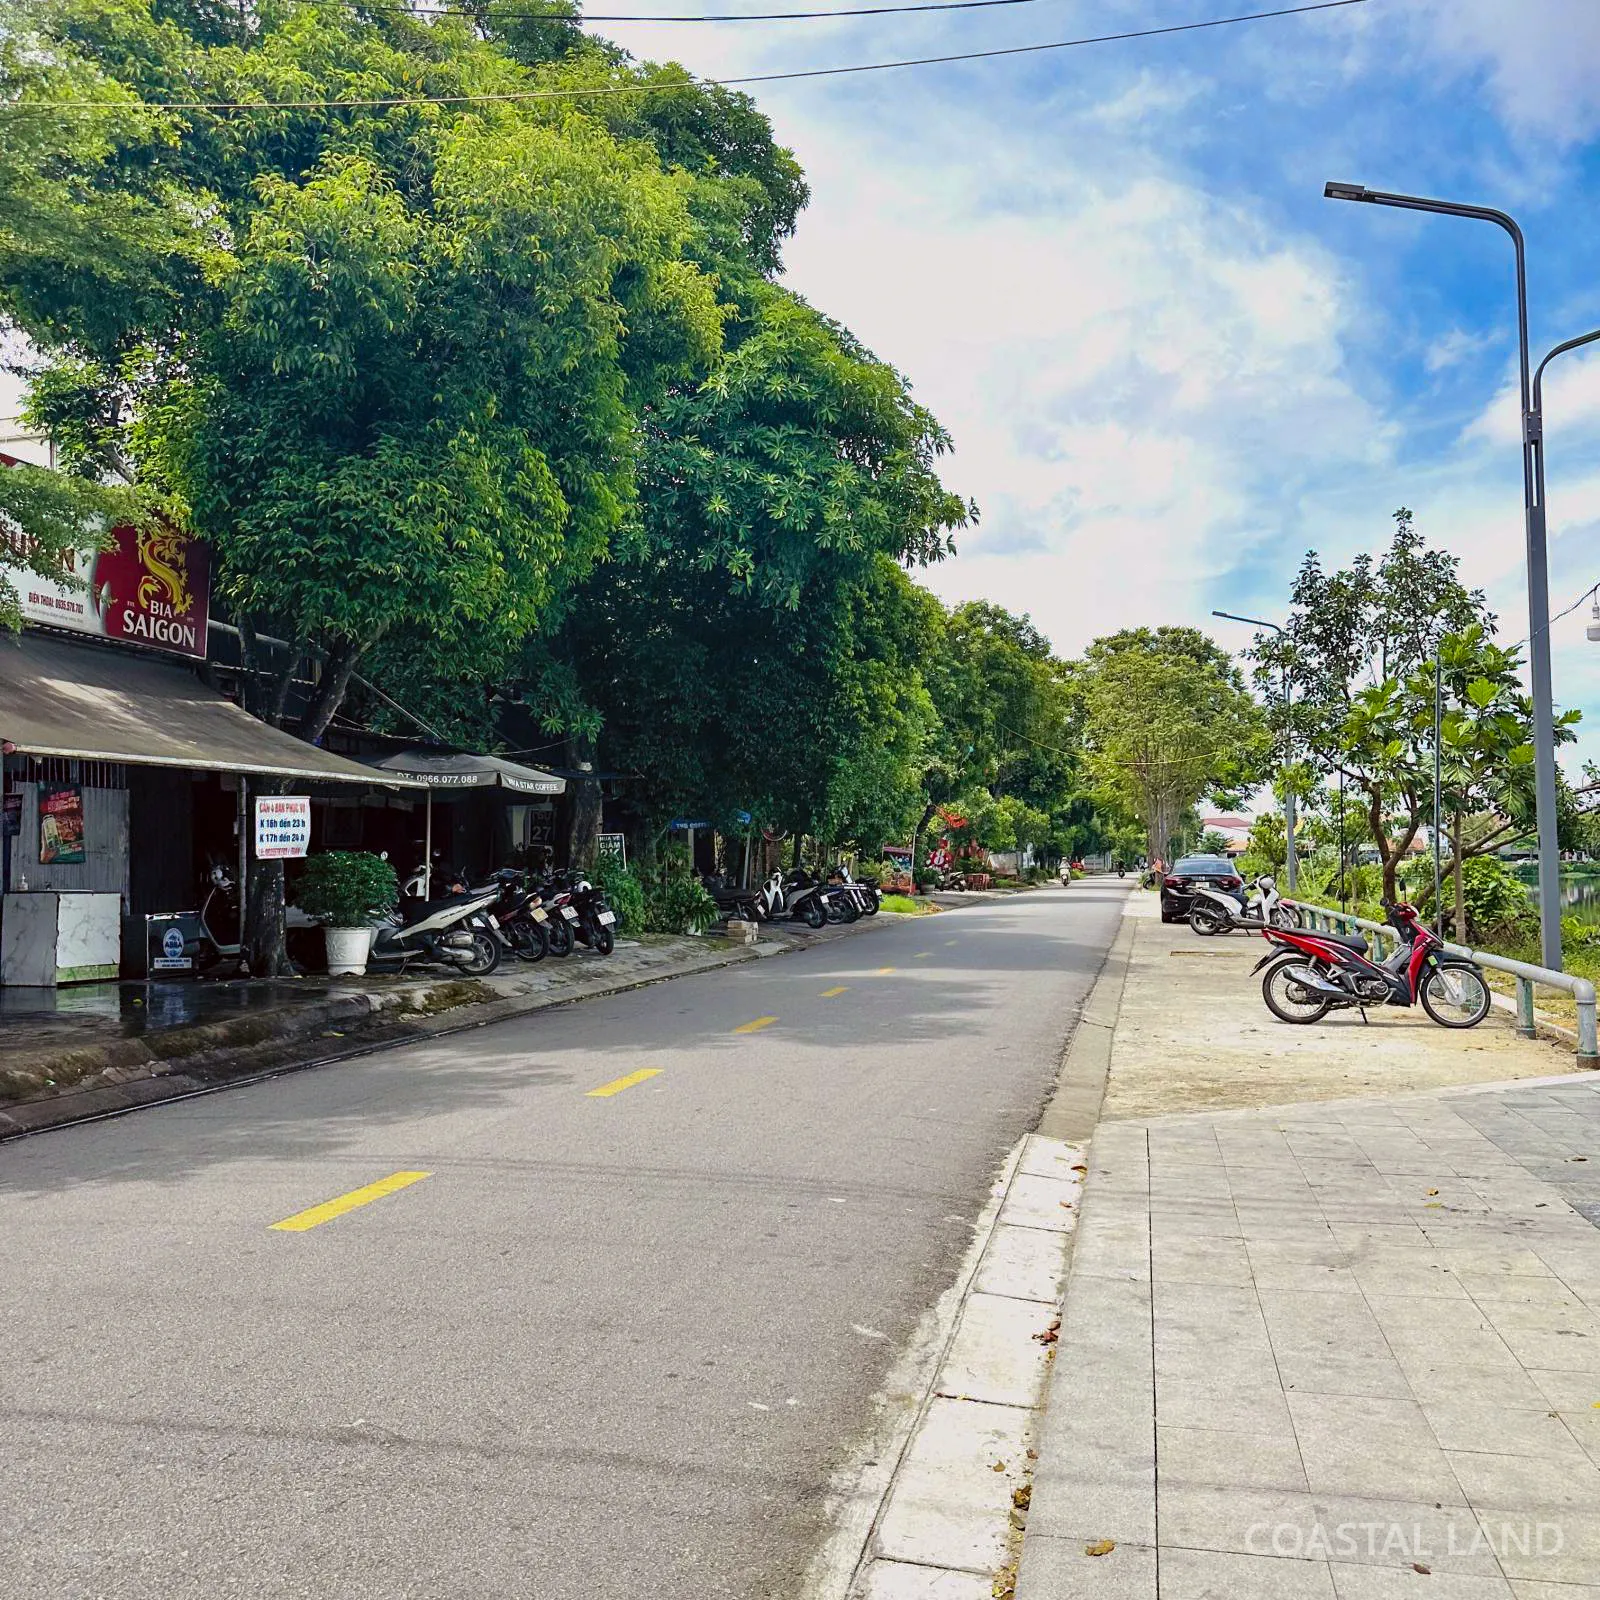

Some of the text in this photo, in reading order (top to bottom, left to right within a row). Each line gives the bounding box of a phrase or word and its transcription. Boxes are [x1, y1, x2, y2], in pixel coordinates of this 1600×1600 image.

[151, 600, 172, 619] BIA
[122, 609, 196, 650] SAIGON
[416, 774, 478, 784] 0966.077.088
[519, 780, 535, 790] STAR
[534, 783, 560, 791] COFFEE
[261, 819, 265, 828] K
[292, 819, 300, 828] 23
[302, 819, 306, 828] h
[260, 834, 264, 842] K
[265, 833, 278, 843] 17h
[532, 826, 552, 841] 27
